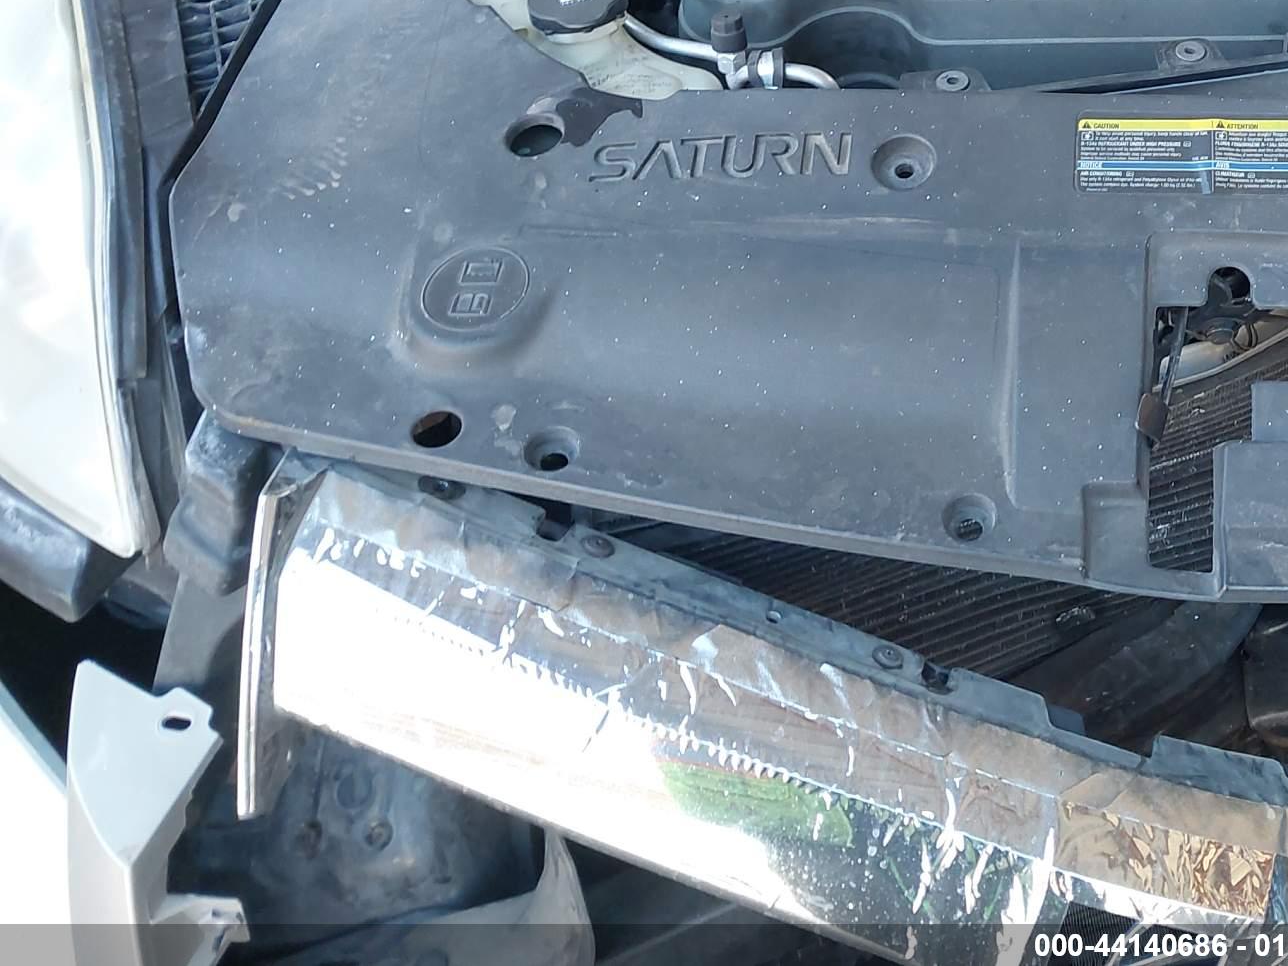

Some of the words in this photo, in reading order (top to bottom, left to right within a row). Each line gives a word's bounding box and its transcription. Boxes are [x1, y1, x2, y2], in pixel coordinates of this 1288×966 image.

[588, 131, 853, 182] SATURN
[1080, 161, 1103, 169] NOTICE
[1215, 161, 1230, 169] AVIS
